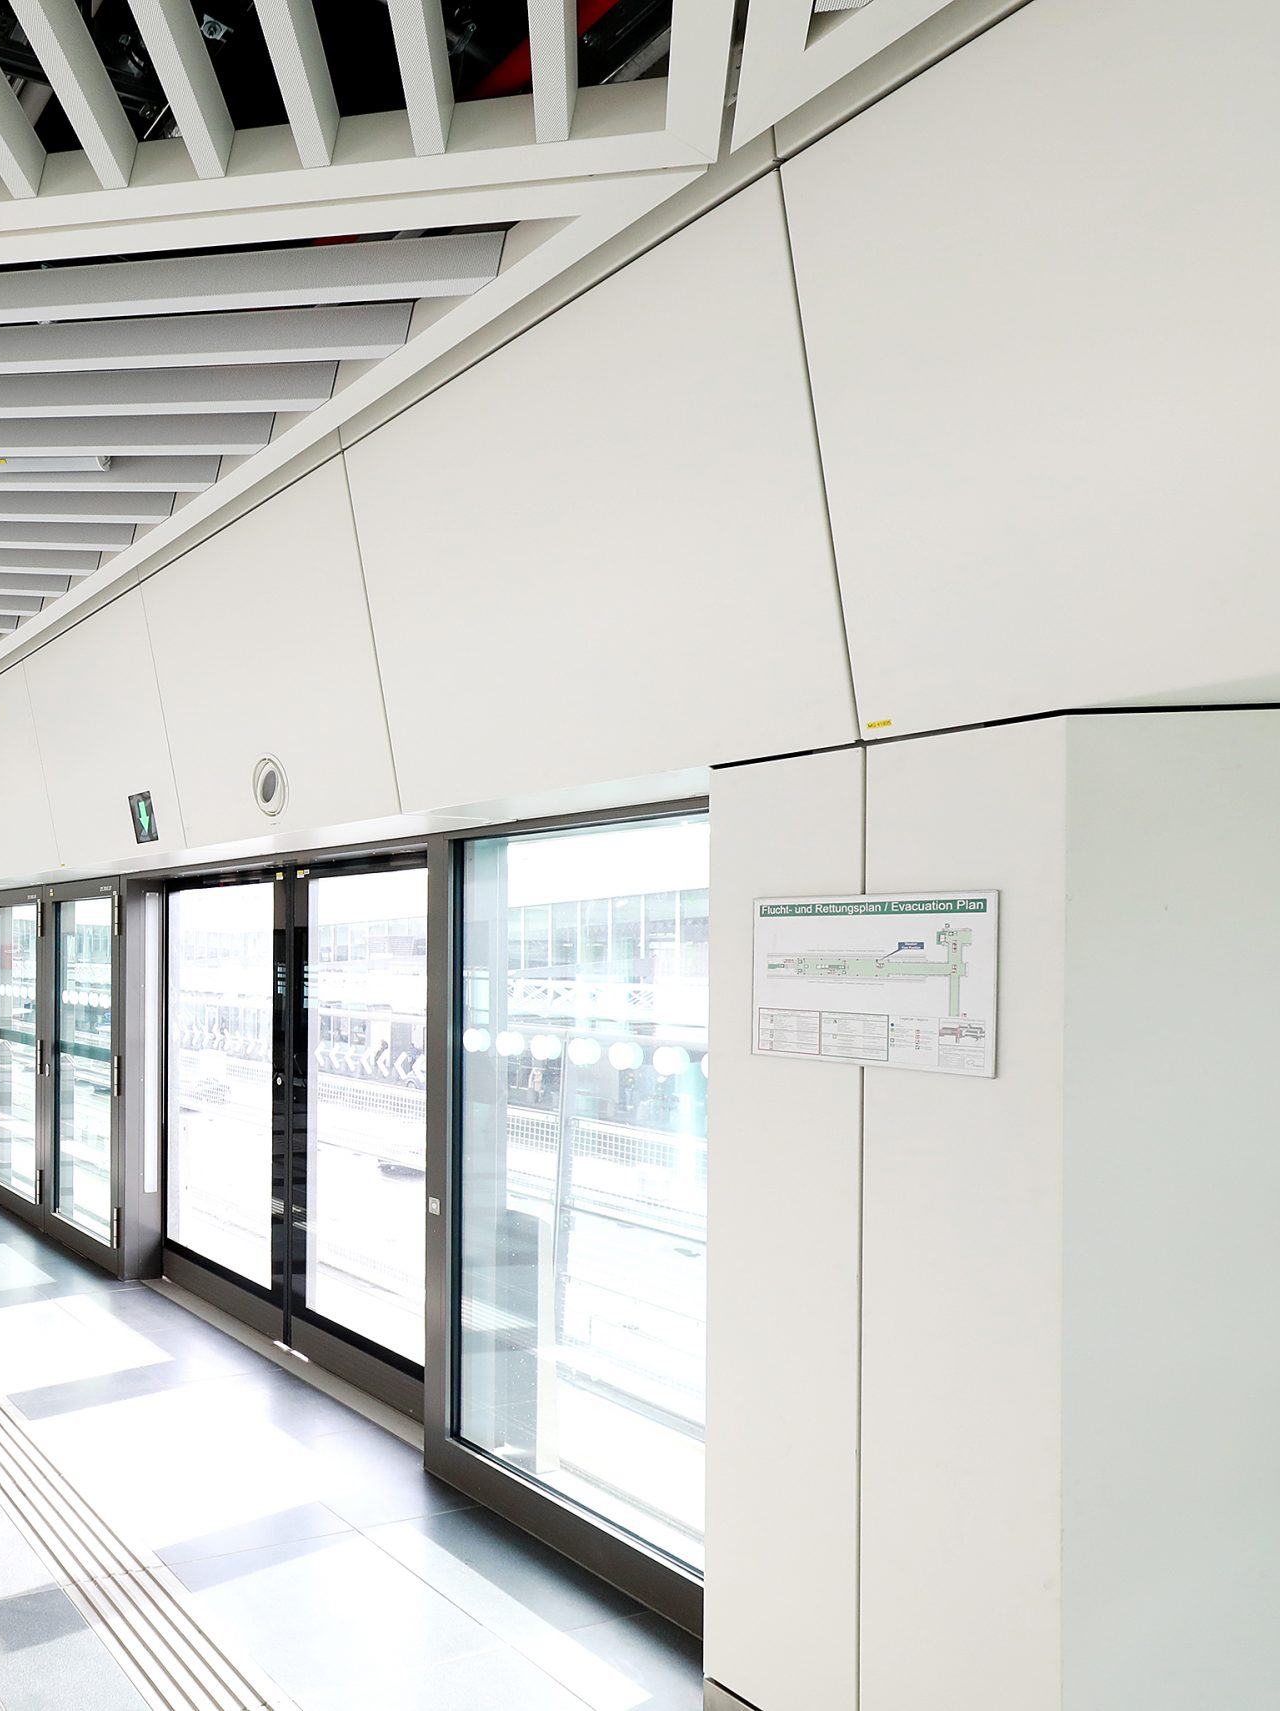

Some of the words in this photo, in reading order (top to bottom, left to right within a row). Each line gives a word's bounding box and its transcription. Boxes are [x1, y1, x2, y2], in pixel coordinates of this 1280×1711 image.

[761, 904, 792, 915] Flucht-
[794, 904, 813, 914] und
[815, 903, 882, 915] Rettungsplan
[891, 900, 953, 912] Evacuation
[956, 899, 984, 910] Plan
